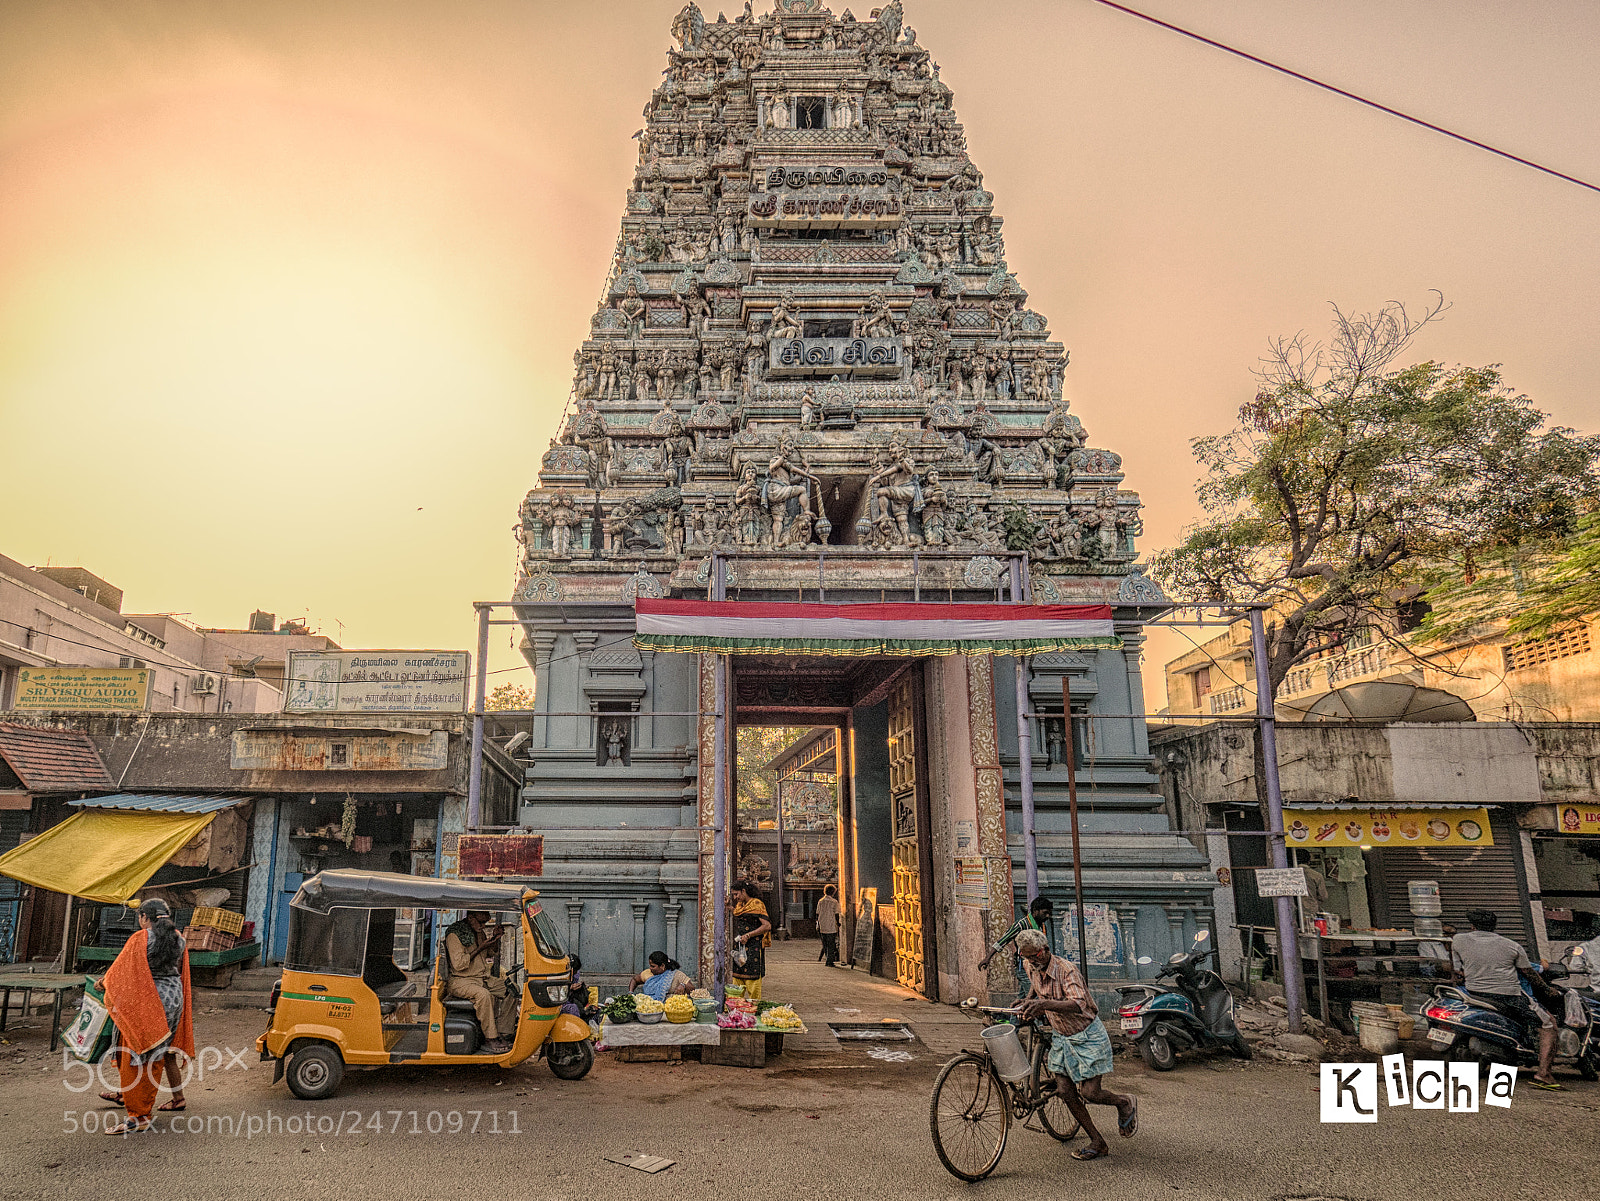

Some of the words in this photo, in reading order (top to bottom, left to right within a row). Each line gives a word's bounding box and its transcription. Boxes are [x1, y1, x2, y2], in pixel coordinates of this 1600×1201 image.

[767, 166, 888, 190] திருமயிலை
[750, 195, 778, 217] ஸ்ரீ
[782, 194, 900, 217] காரணீச்சரம்
[781, 339, 834, 365] சிவ
[842, 339, 897, 365] சிவ
[350, 657, 399, 668] திருமயிலை
[26, 688, 48, 696] SRI
[94, 688, 137, 697] AUDIO
